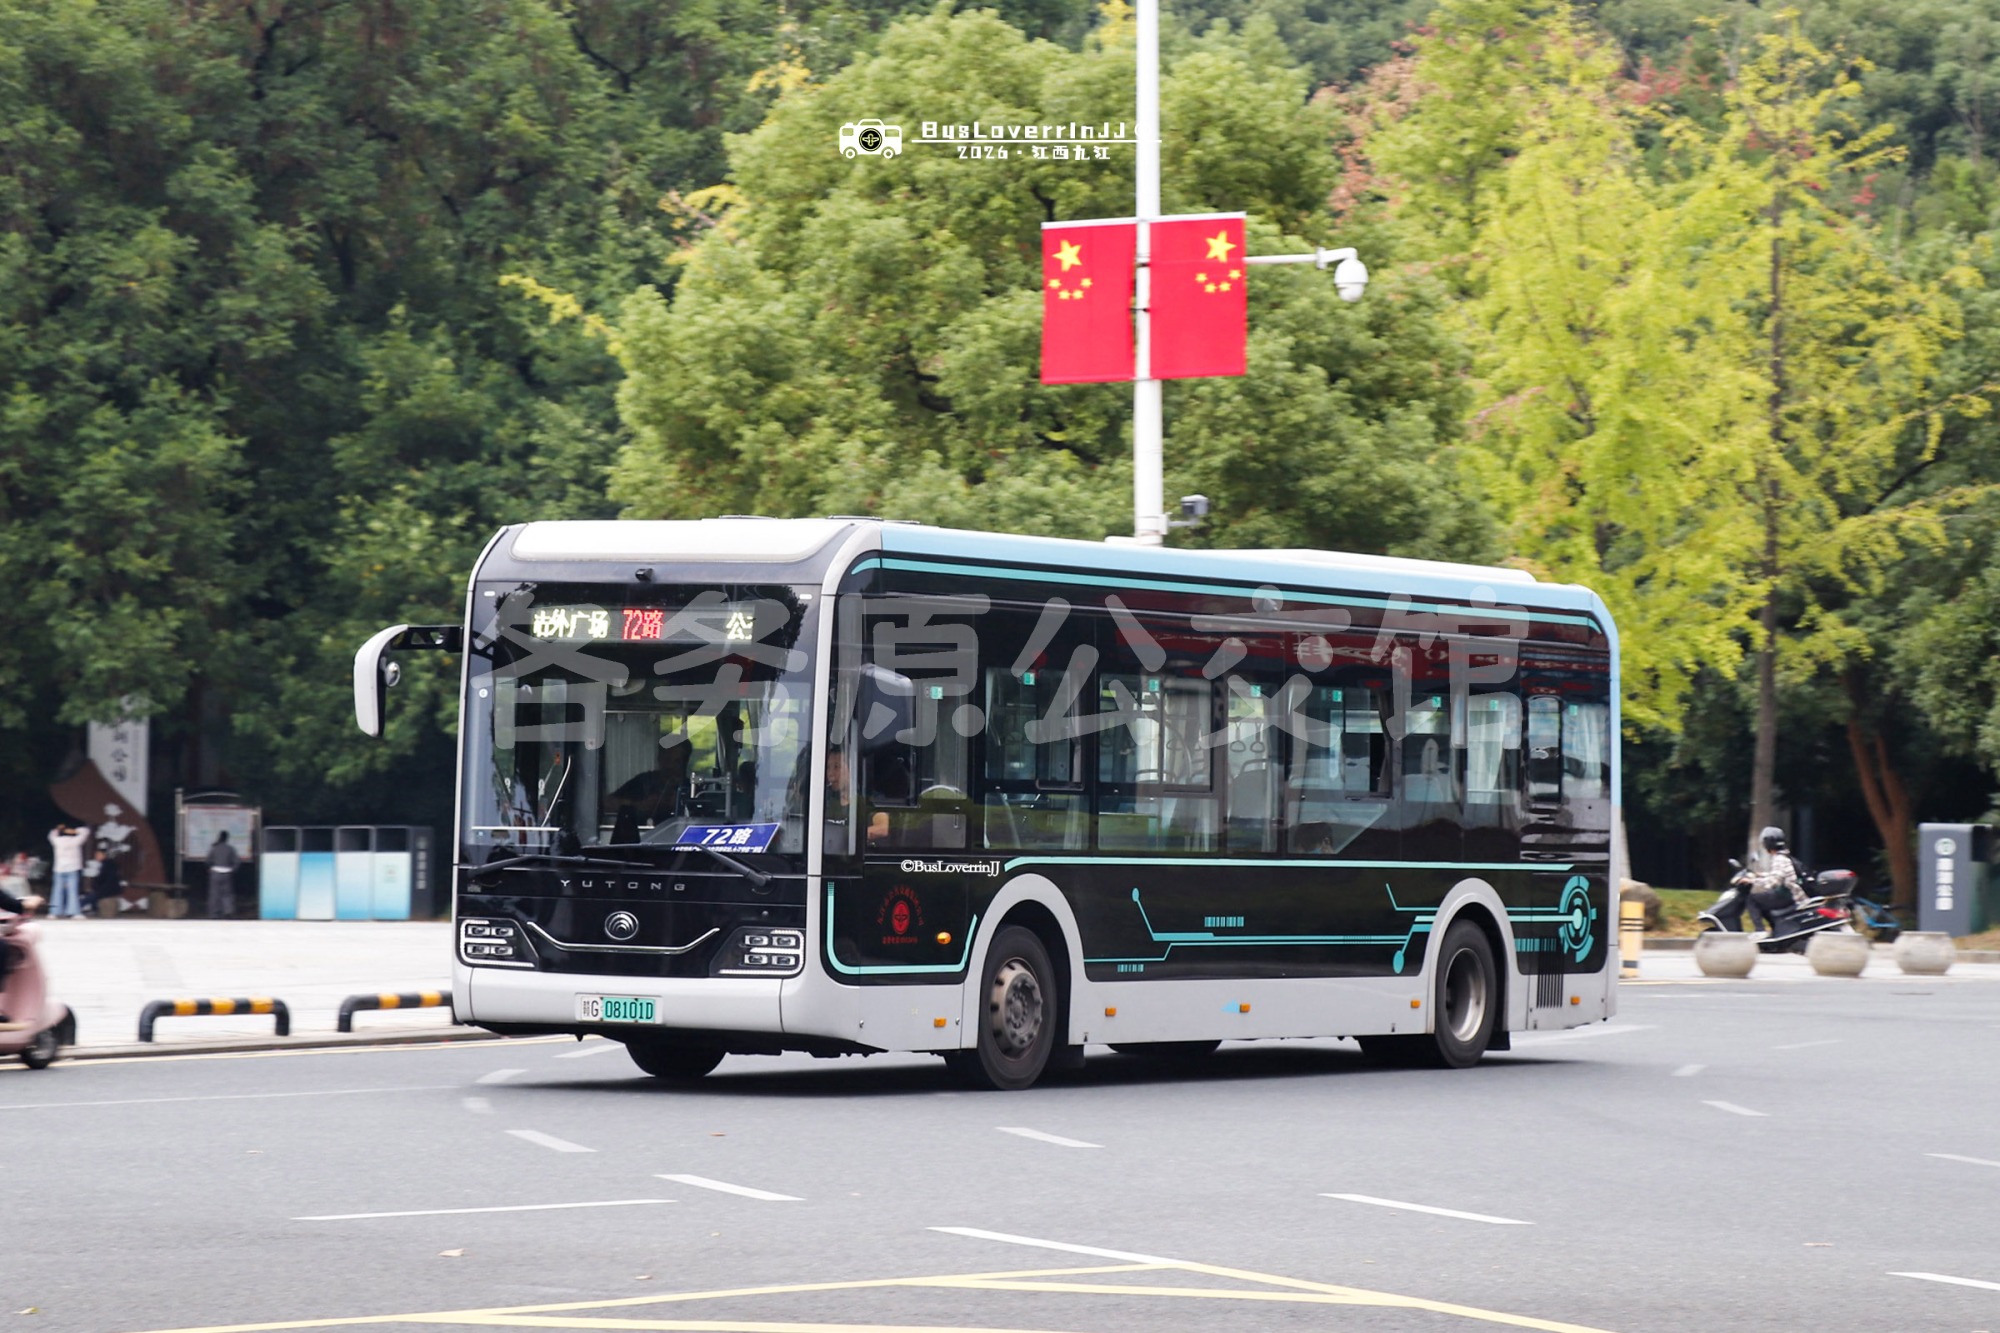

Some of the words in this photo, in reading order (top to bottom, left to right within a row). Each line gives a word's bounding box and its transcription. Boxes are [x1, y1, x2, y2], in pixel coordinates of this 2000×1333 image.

[622, 609, 664, 640] 72路
[701, 827, 753, 845] 72路
[560, 879, 685, 891] YUTONG
